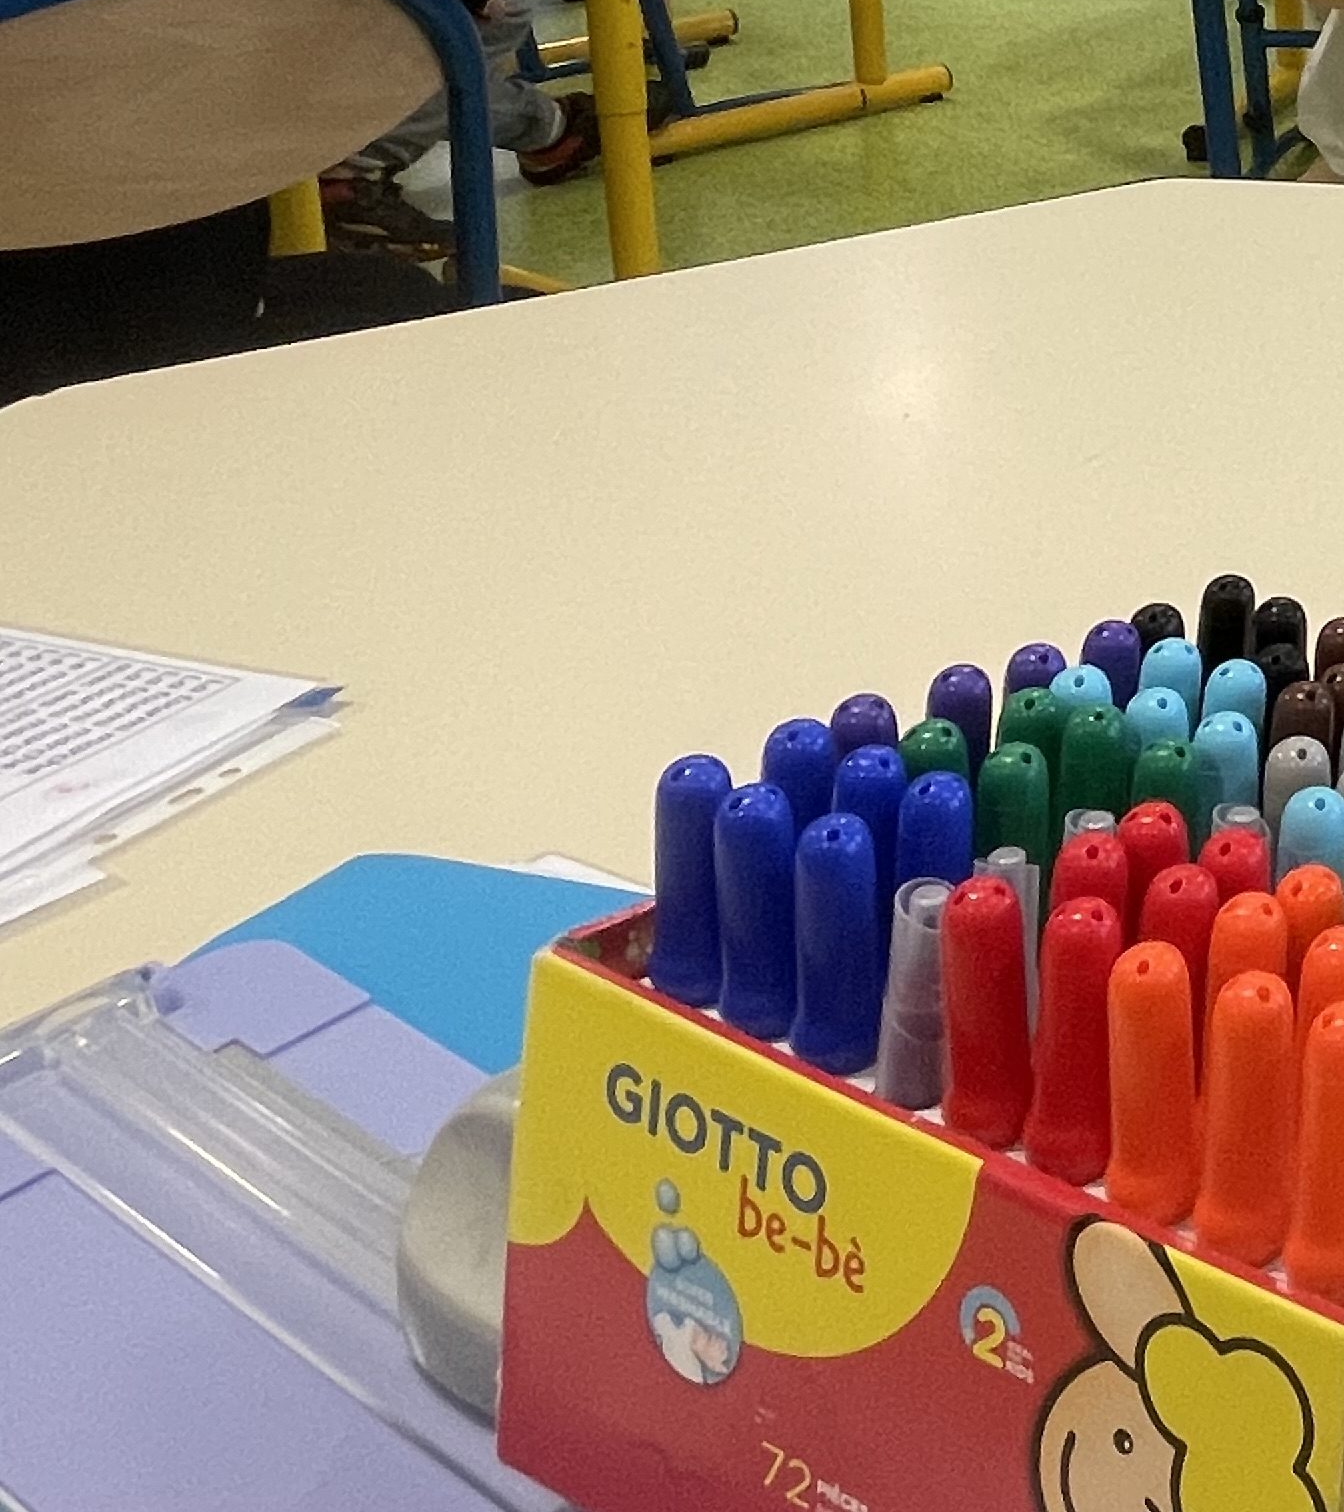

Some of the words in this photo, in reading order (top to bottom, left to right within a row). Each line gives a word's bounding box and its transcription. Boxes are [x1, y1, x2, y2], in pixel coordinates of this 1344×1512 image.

[605, 1062, 828, 1215] GIOTTO
[736, 1174, 865, 1294] be-bè
[971, 1305, 1005, 1369] 2
[760, 1439, 812, 1509] 72
